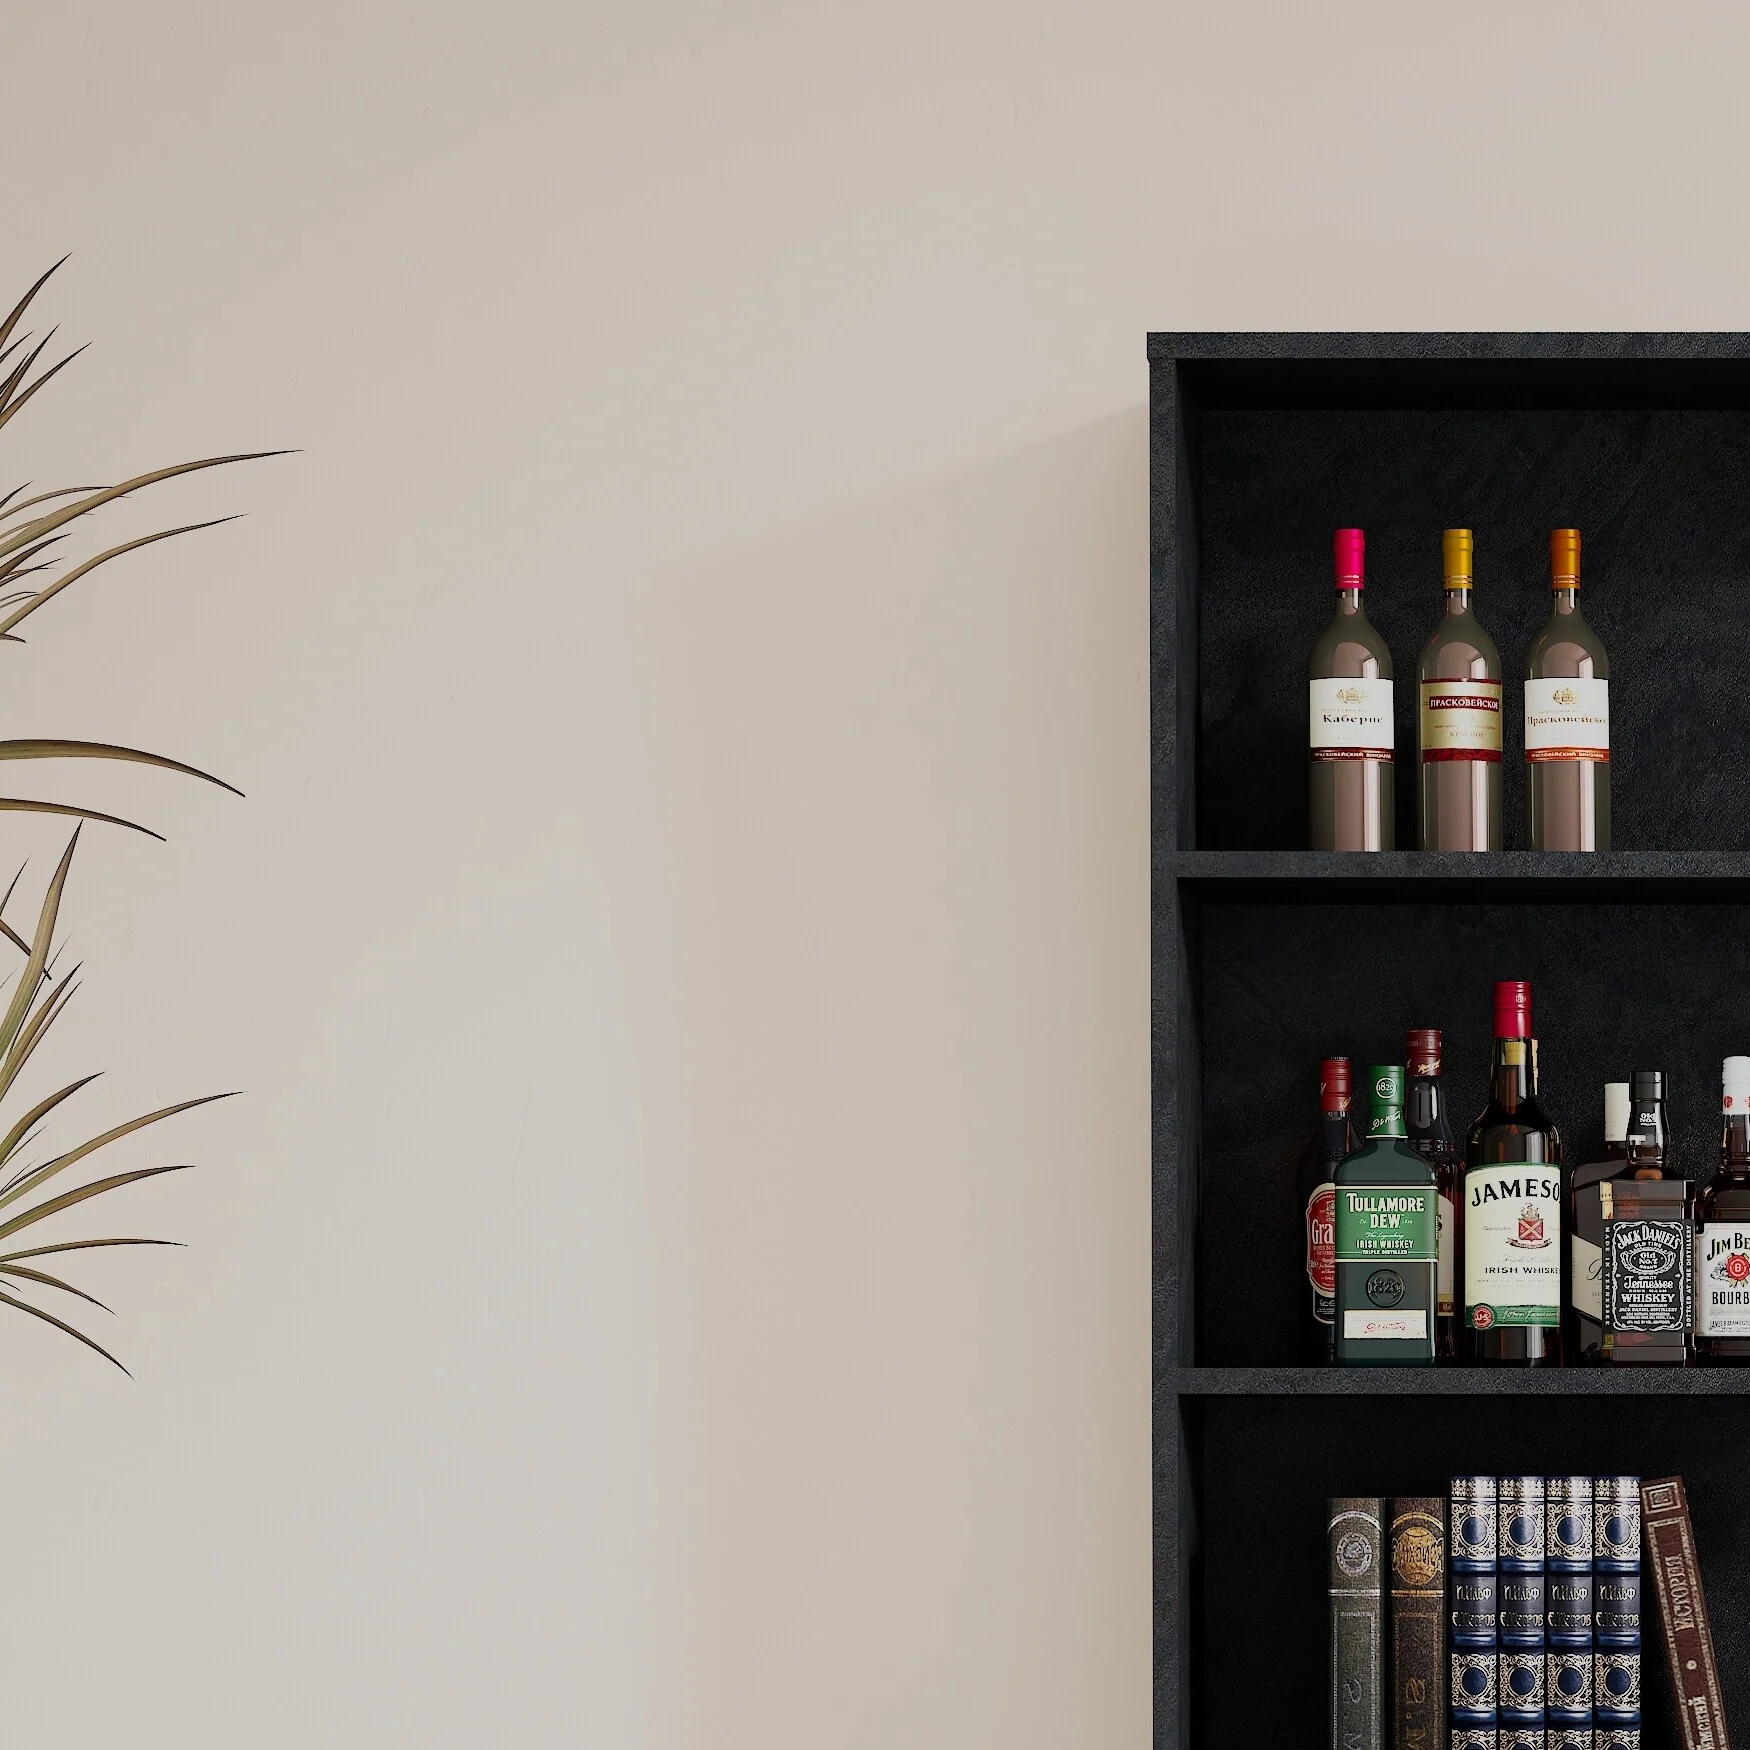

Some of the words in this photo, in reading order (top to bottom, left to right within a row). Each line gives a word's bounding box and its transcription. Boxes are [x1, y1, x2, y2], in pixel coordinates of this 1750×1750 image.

[1472, 1178, 1560, 1207] JAMESO
[1346, 1192, 1425, 1213] TULLAMORE
[1356, 1240, 1378, 1249] IRISH
[1380, 1240, 1414, 1249] WHISKEY
[1617, 1230, 1642, 1249] JACK
[1707, 1238, 1731, 1261] JIM
[1624, 1276, 1673, 1289] Tennessee
[1621, 1294, 1676, 1303] WHISKEY
